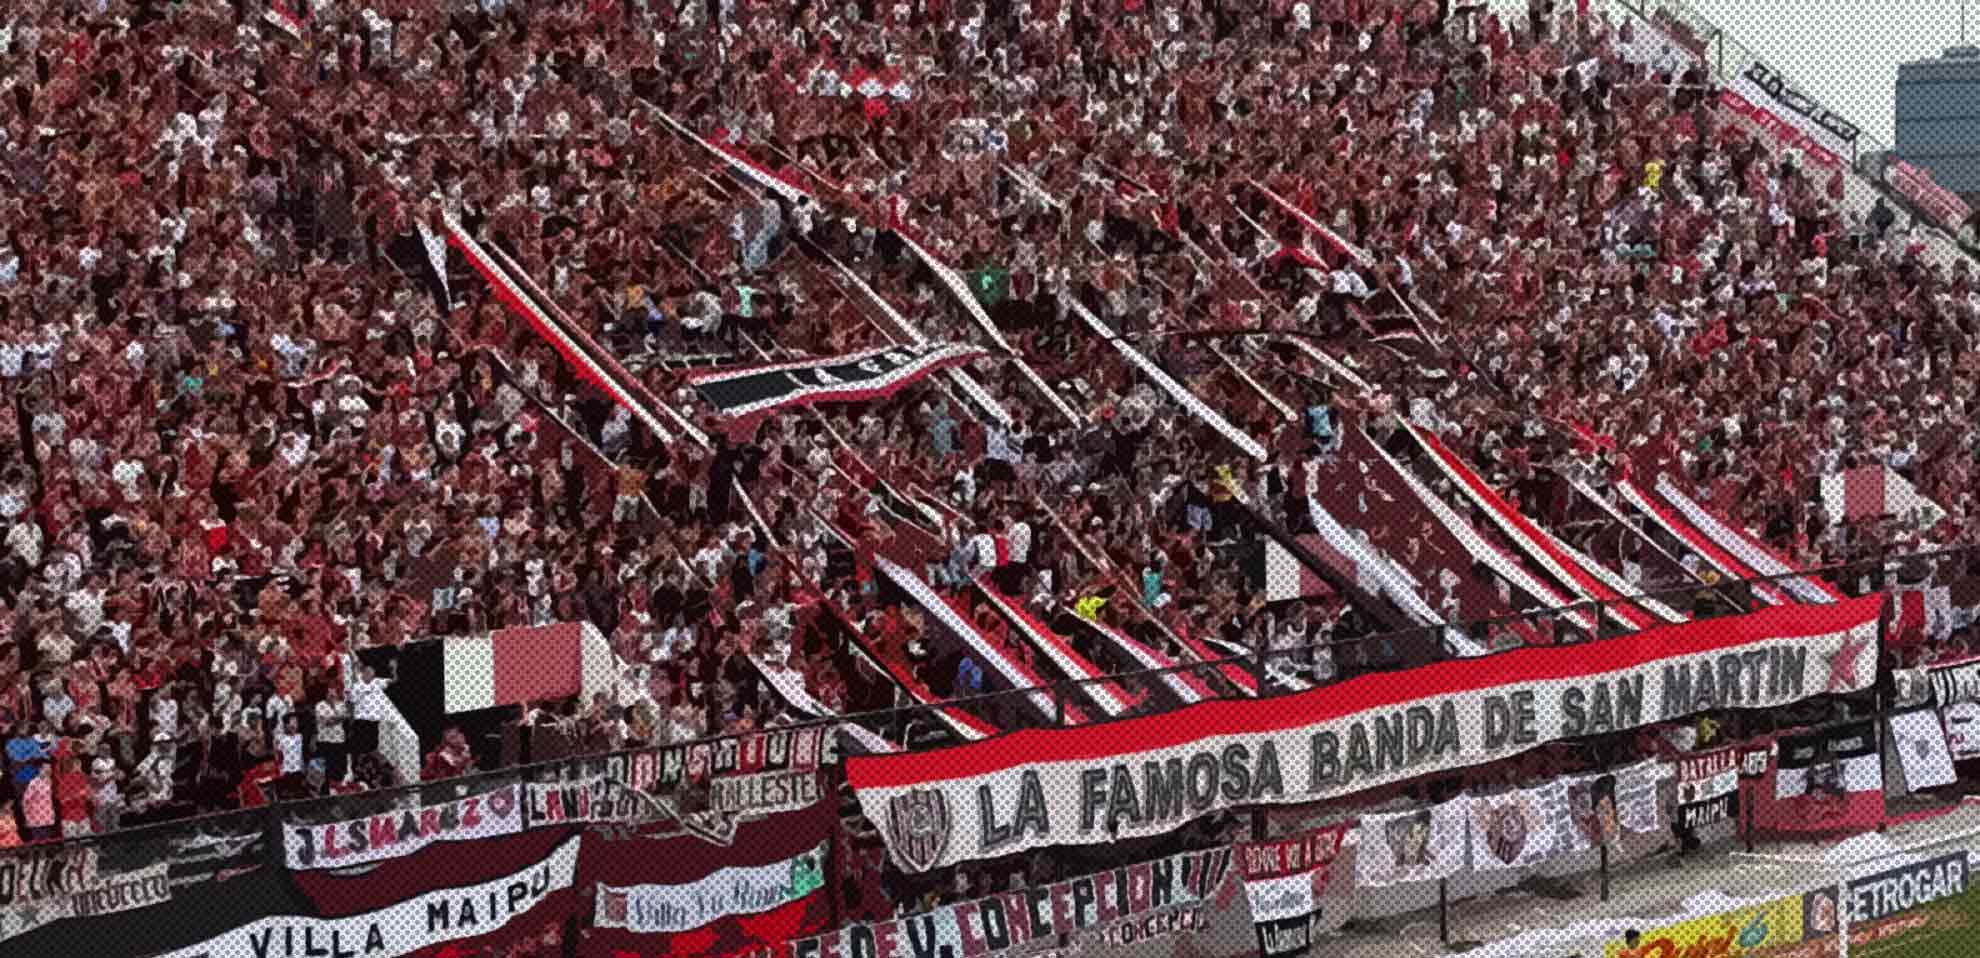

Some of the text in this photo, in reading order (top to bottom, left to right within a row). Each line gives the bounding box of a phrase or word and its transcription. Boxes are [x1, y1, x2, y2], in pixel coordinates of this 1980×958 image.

[976, 769, 1049, 853] LA
[1079, 740, 1284, 834] FAMOSA
[1307, 700, 1461, 791] BANDA
[1483, 689, 1538, 750] DE
[1560, 673, 1644, 737] SAN
[1660, 646, 1807, 717] MARTIN
[1685, 796, 1729, 829] MAIPU
[249, 862, 552, 958] VILLA MAIPU
[954, 858, 1173, 958] CONCEPCION
